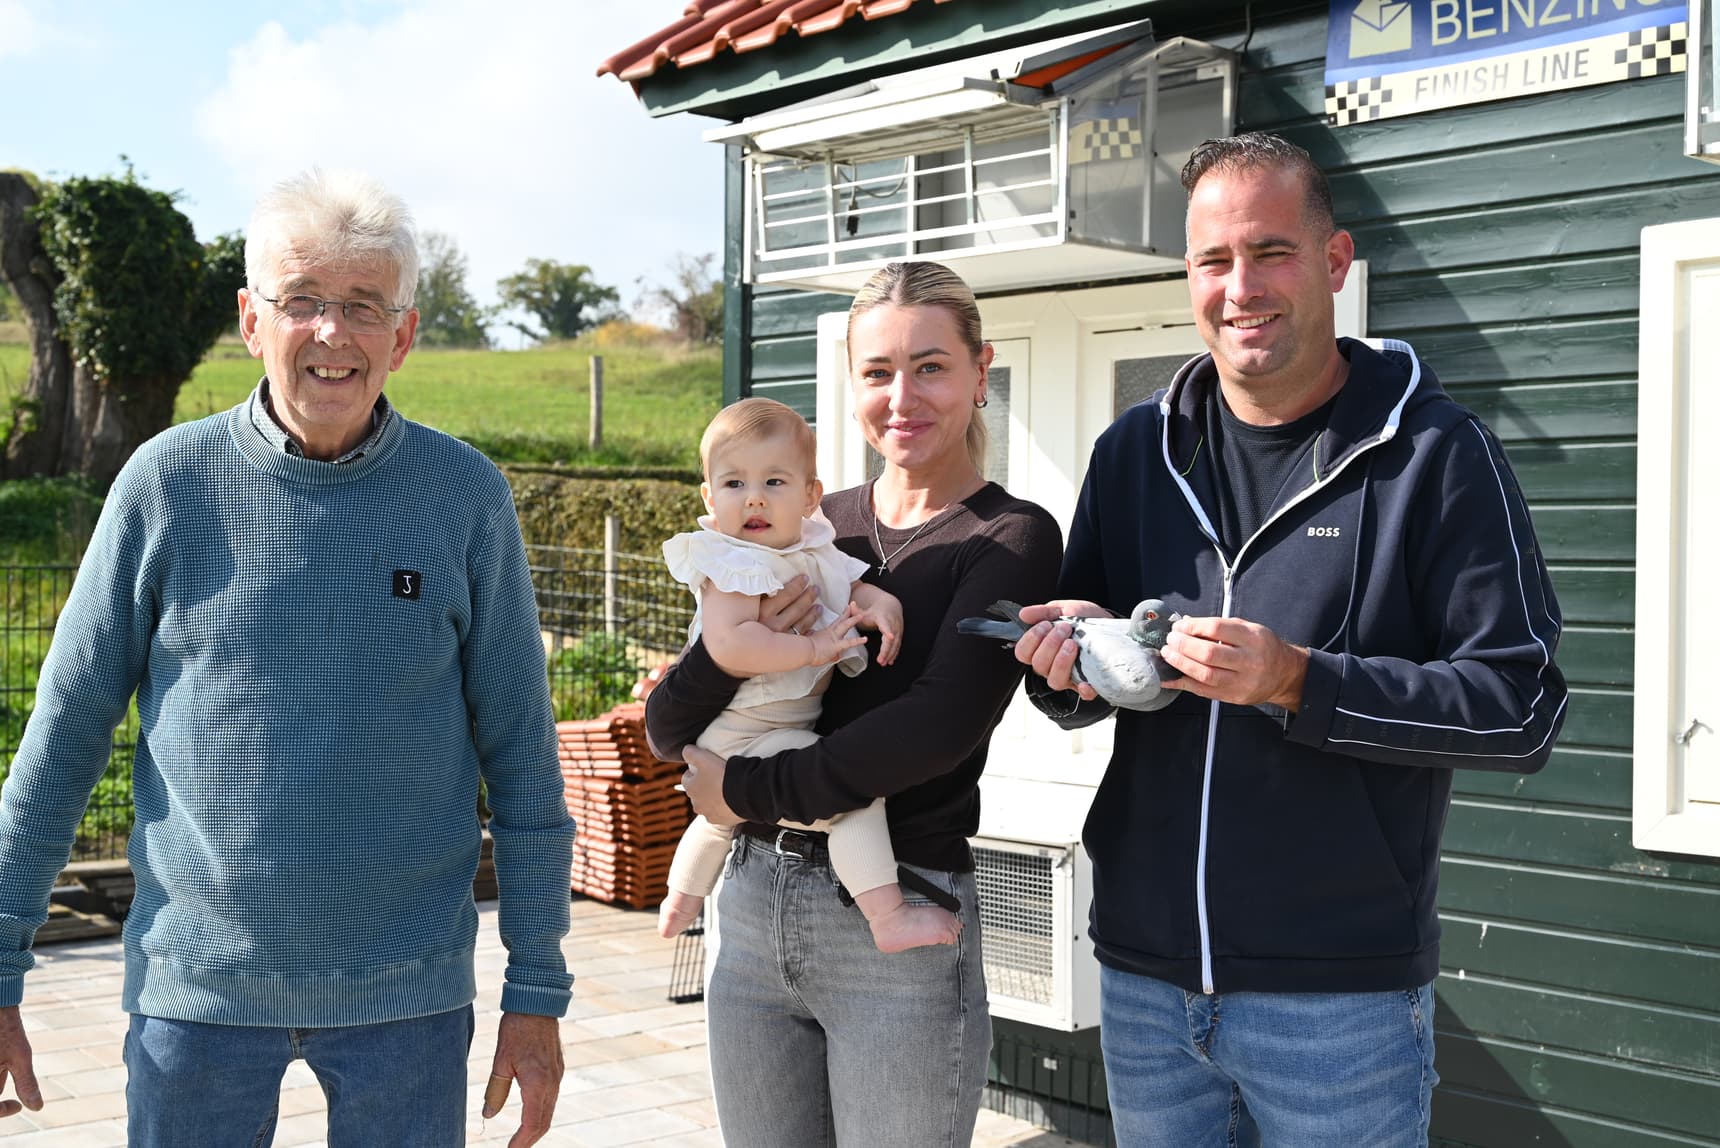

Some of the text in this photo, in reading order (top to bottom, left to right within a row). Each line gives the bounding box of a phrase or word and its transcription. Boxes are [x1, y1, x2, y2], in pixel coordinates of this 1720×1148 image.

[1414, 48, 1590, 104] FINISH LINE
[1307, 527, 1340, 537] BOSS
